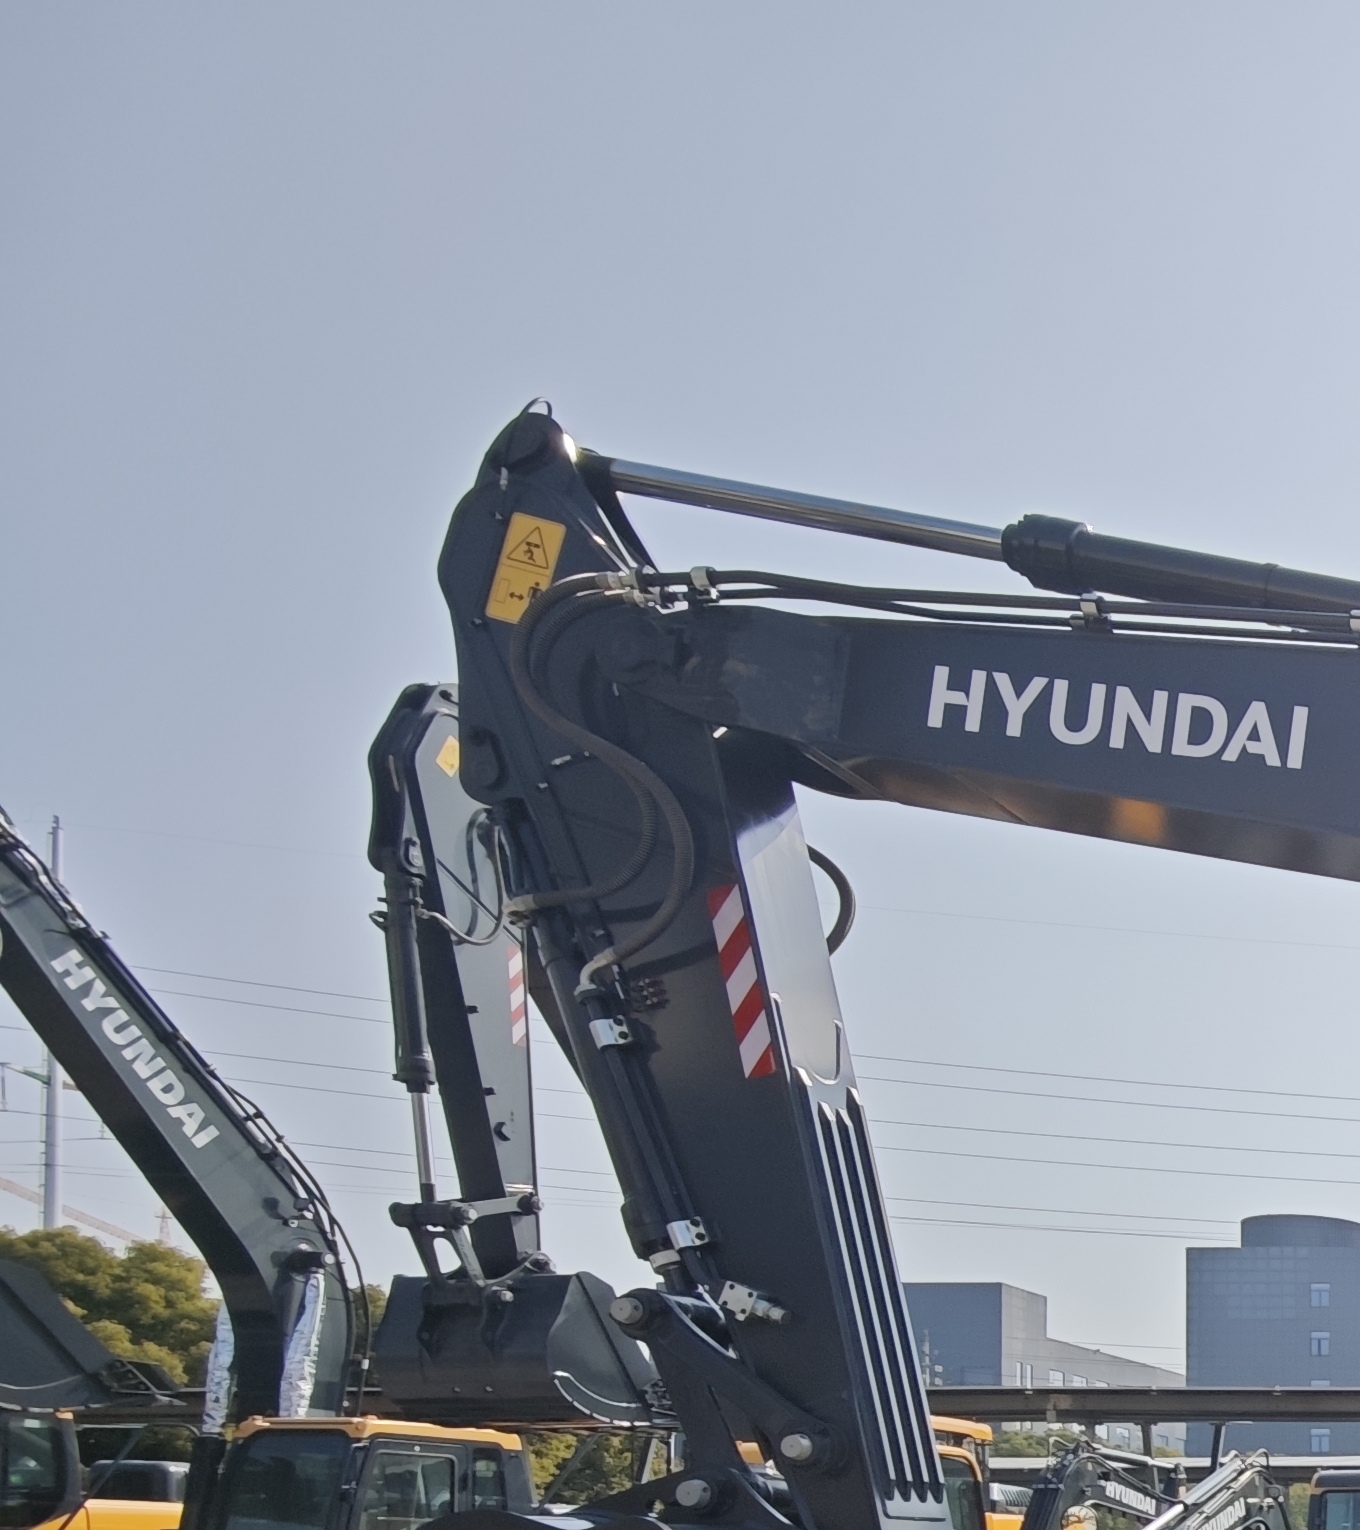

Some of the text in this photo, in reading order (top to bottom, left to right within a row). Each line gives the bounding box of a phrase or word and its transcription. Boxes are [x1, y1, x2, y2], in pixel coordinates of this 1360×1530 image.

[927, 665, 1309, 769] HYUNDAI
[51, 949, 220, 1148] HYUNDAI
[1106, 1481, 1156, 1515] HYUNDAI
